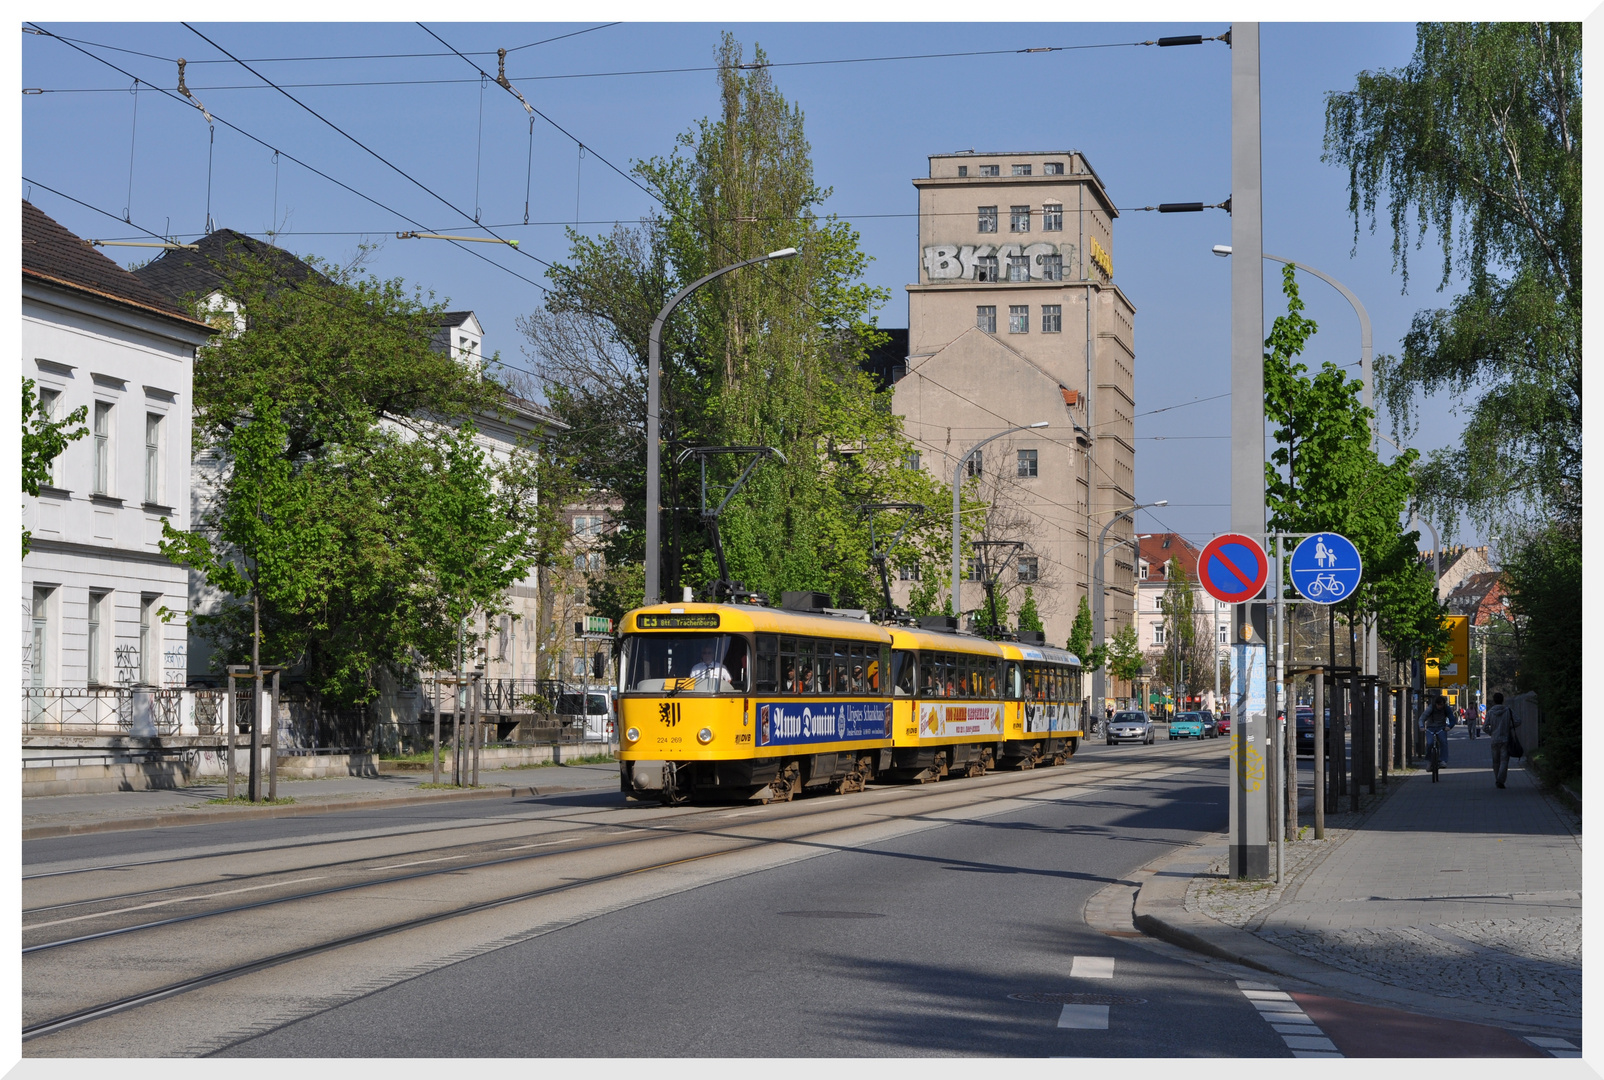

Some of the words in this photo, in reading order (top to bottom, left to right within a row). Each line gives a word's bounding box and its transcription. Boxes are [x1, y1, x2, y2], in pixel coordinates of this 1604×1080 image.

[643, 617, 657, 627] E3
[677, 619, 717, 627] Trachenberge
[773, 707, 801, 738] Anno
[803, 706, 835, 738] Domini
[741, 733, 751, 742] DVB
